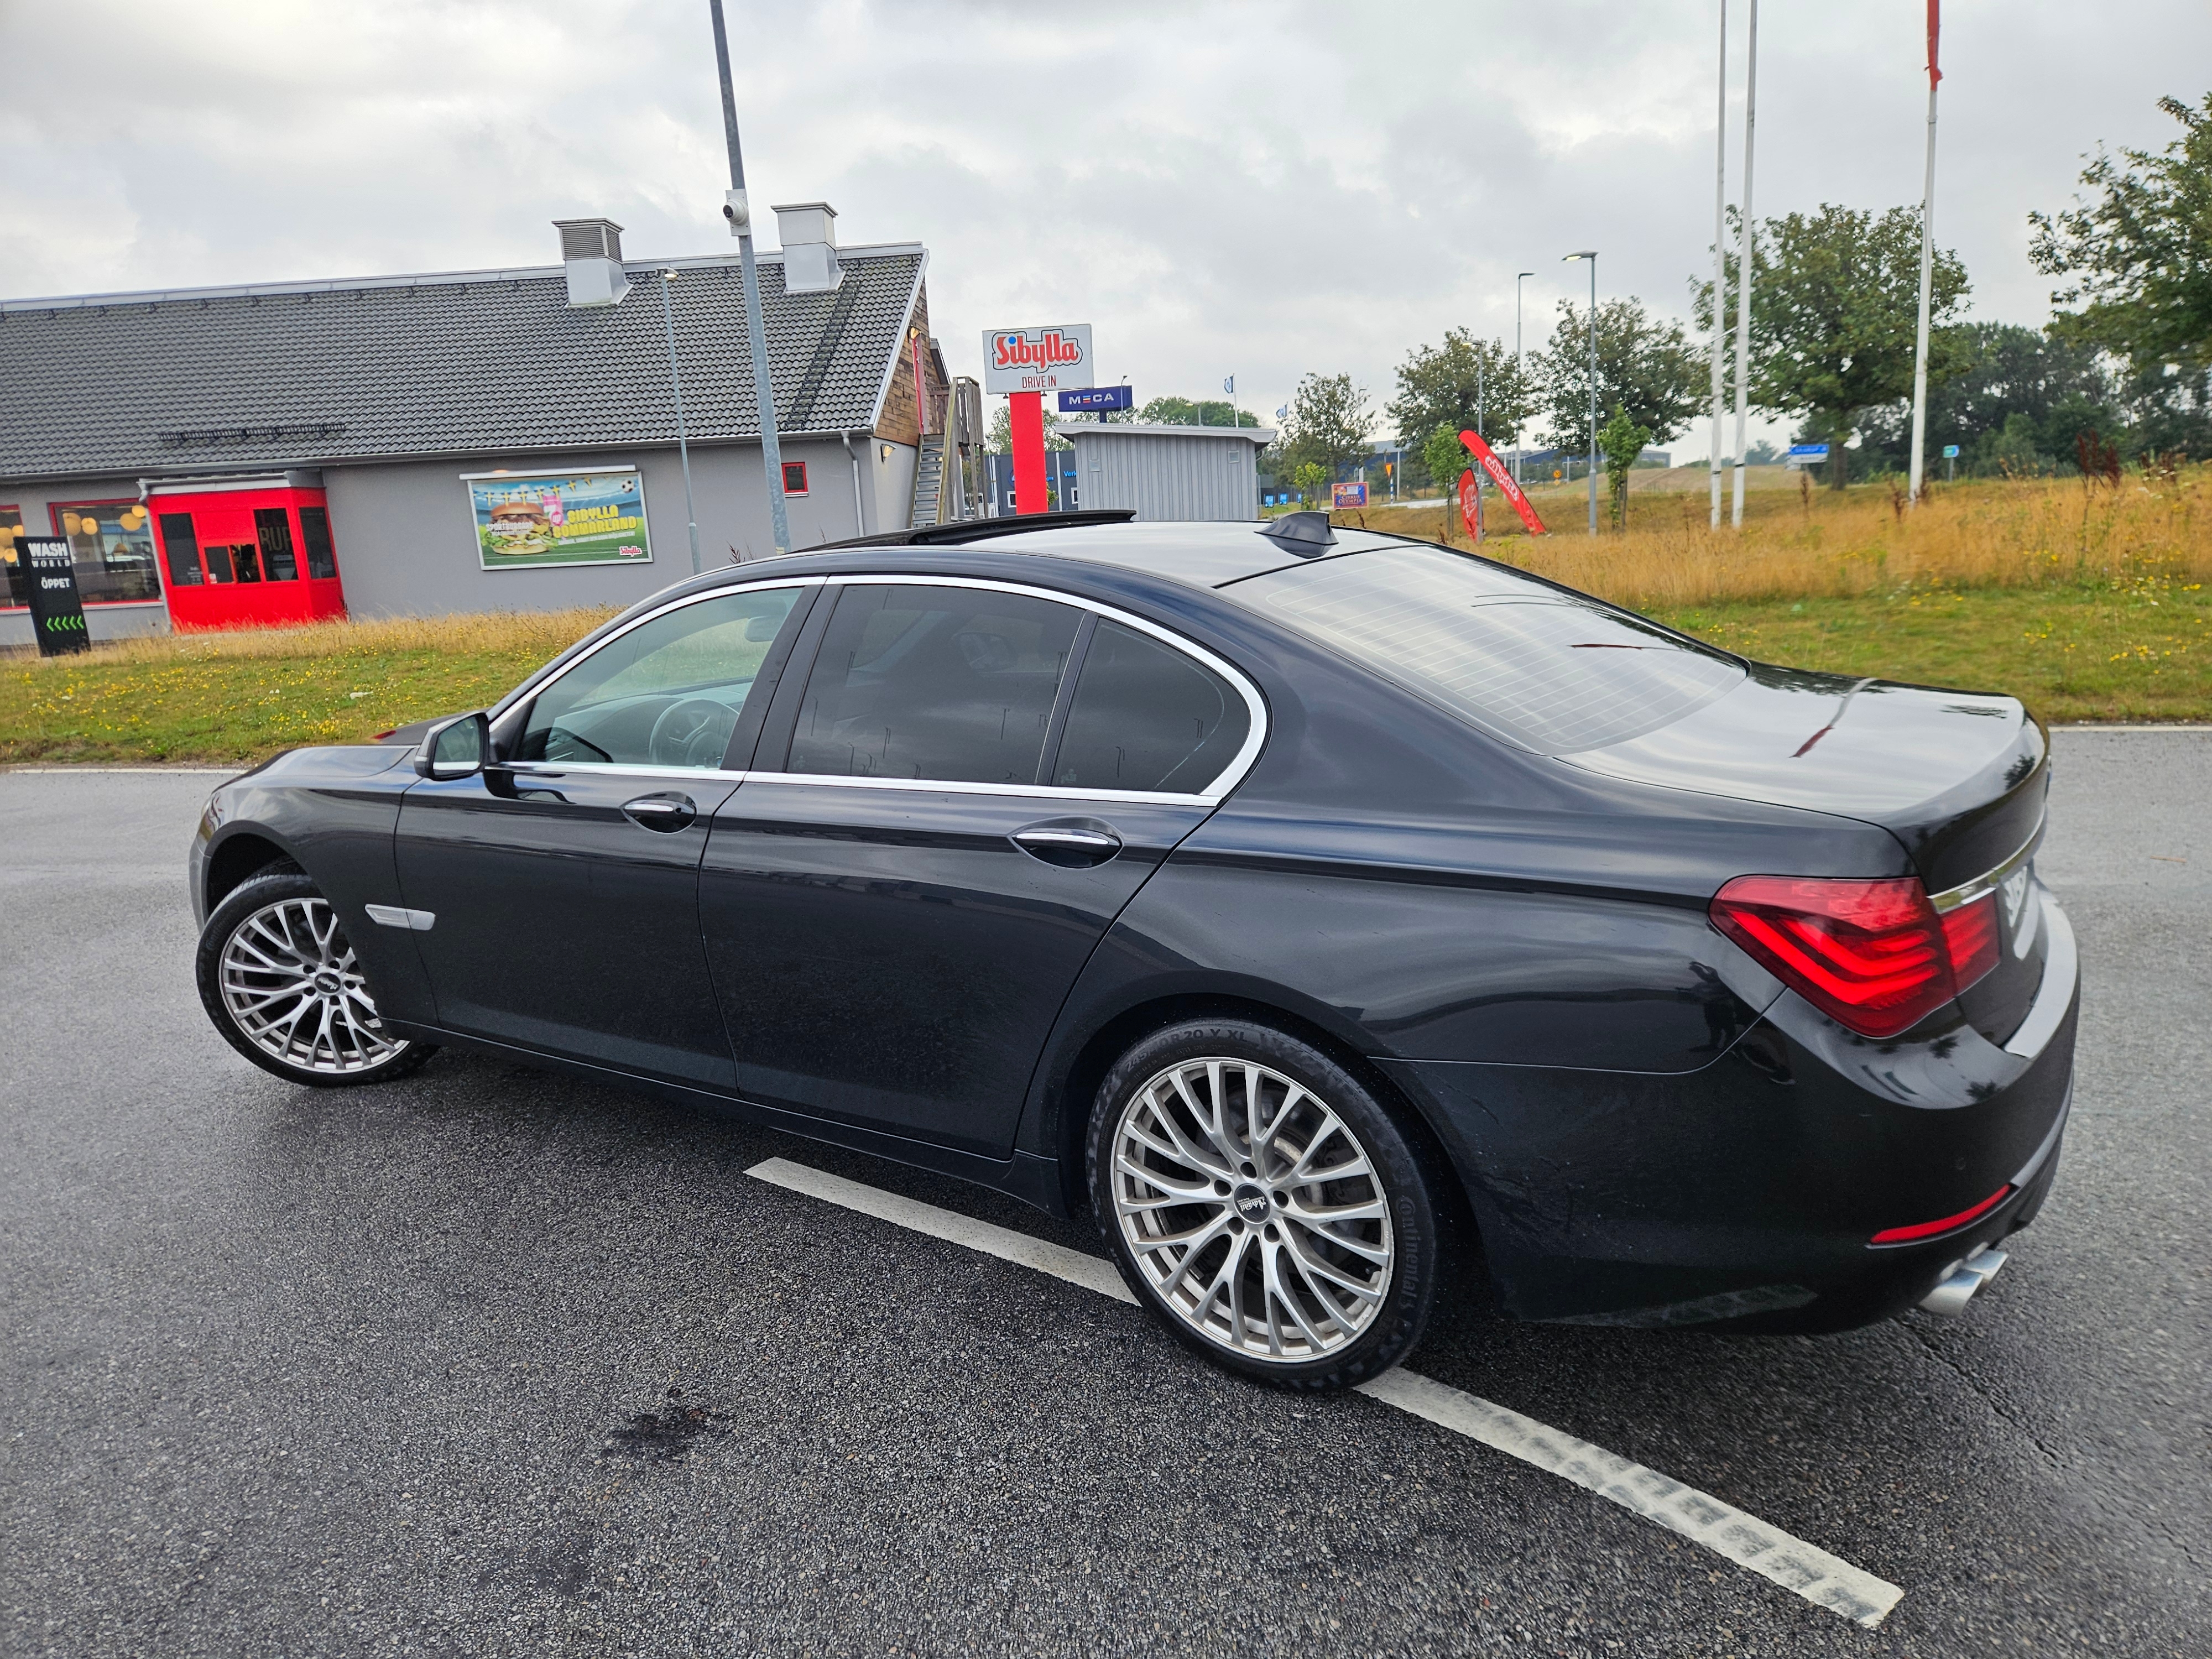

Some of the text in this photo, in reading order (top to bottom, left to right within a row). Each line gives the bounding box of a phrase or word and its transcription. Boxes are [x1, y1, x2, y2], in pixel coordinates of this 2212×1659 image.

[997, 333, 1078, 369] Sibylla
[1022, 375, 1057, 389] DRIVE IN
[1068, 393, 1114, 405] MECA
[567, 504, 619, 524] SIBYLLA
[553, 515, 638, 539] SOMMARLAND
[28, 542, 68, 557] WASH
[620, 546, 641, 556] Sibylla
[32, 559, 70, 568] WORLD
[41, 577, 70, 589] ÖPPET
